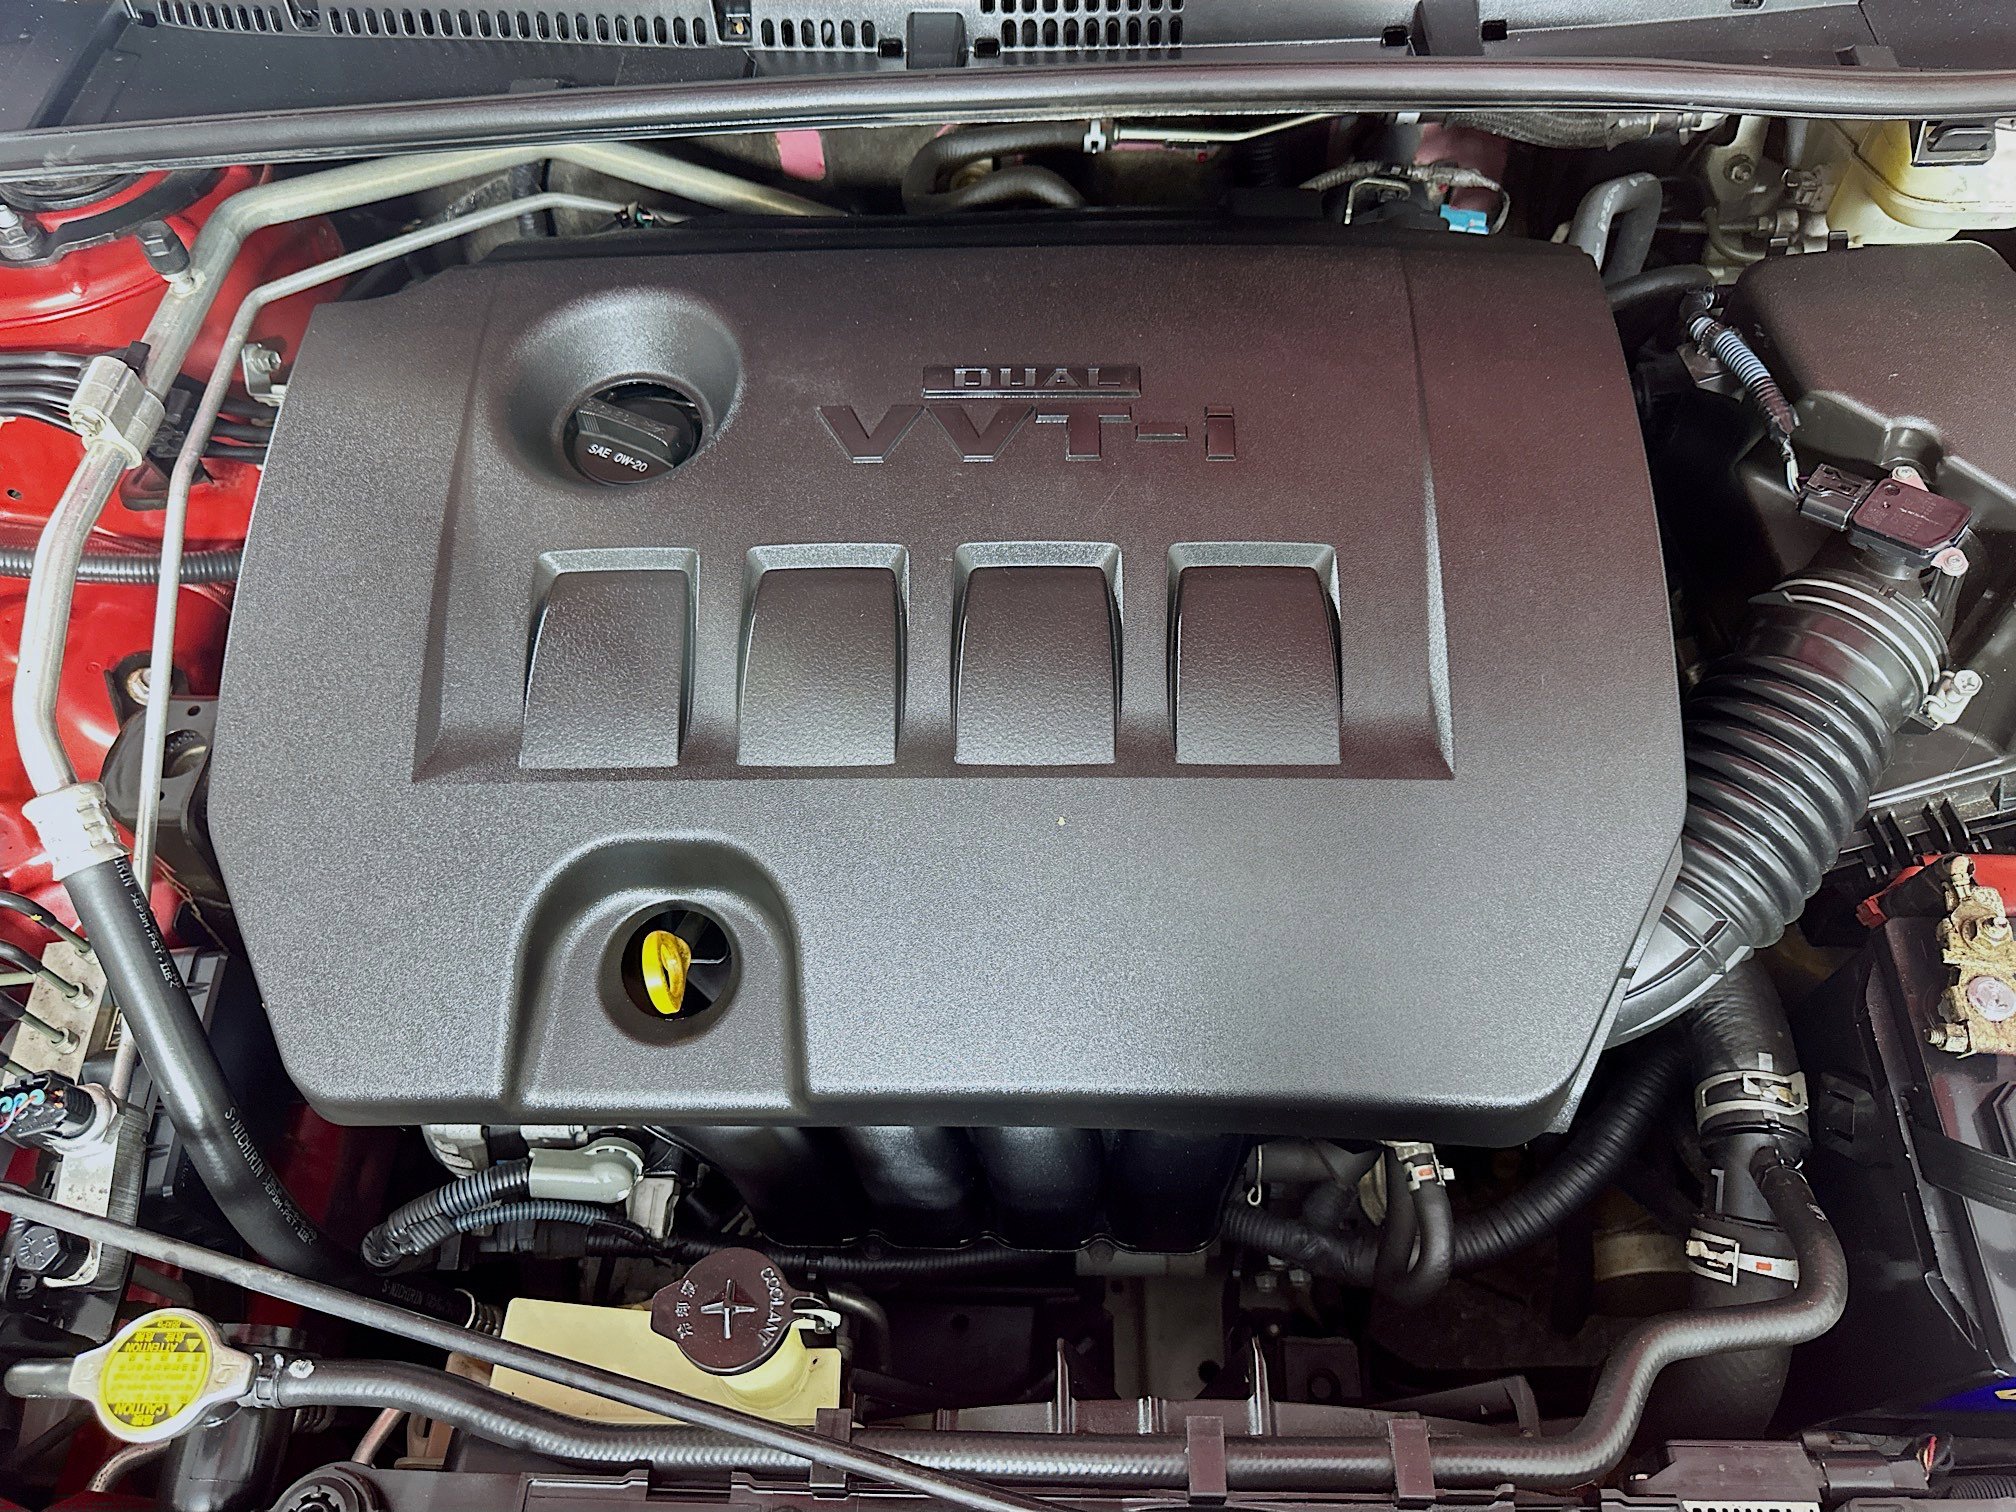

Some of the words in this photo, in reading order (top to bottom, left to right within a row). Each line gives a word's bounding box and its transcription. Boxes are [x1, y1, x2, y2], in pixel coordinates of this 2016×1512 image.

[953, 367, 1121, 388] DUAL
[815, 404, 1237, 464] VVT-i
[587, 443, 613, 459] SAE
[613, 452, 648, 473] 0W-20
[758, 1267, 785, 1347] COOLANT
[124, 1342, 179, 1353] ATTENTION
[113, 1403, 167, 1415] CAUTION
